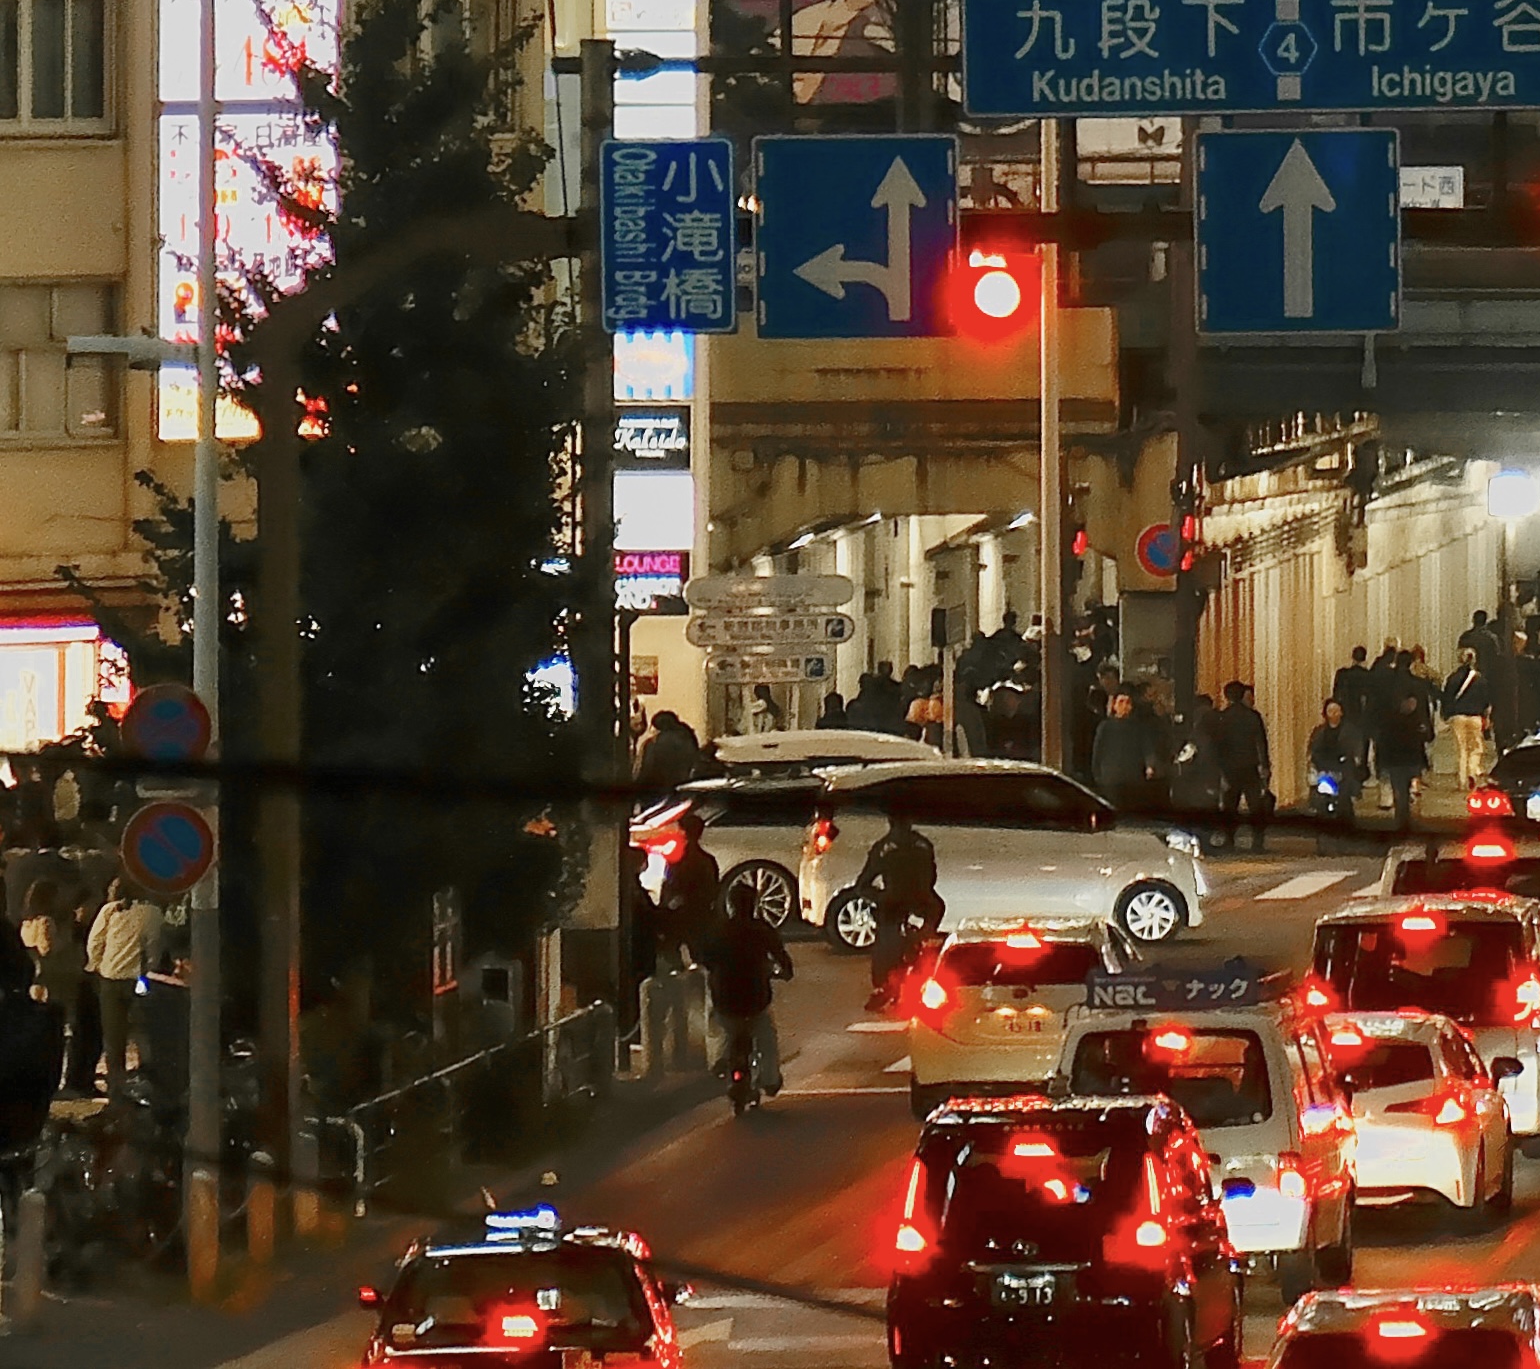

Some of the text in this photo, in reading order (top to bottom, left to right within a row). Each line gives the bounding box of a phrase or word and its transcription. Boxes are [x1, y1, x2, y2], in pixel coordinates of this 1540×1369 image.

[1276, 30, 1301, 65] 4
[1031, 68, 1228, 103] Kudanshita
[1370, 65, 1517, 102] Ichigaya
[611, 147, 658, 264] Otakibashi
[659, 151, 725, 322] 小滝橋
[614, 555, 682, 574] LOUNGE
[1184, 978, 1249, 1001] ナック
